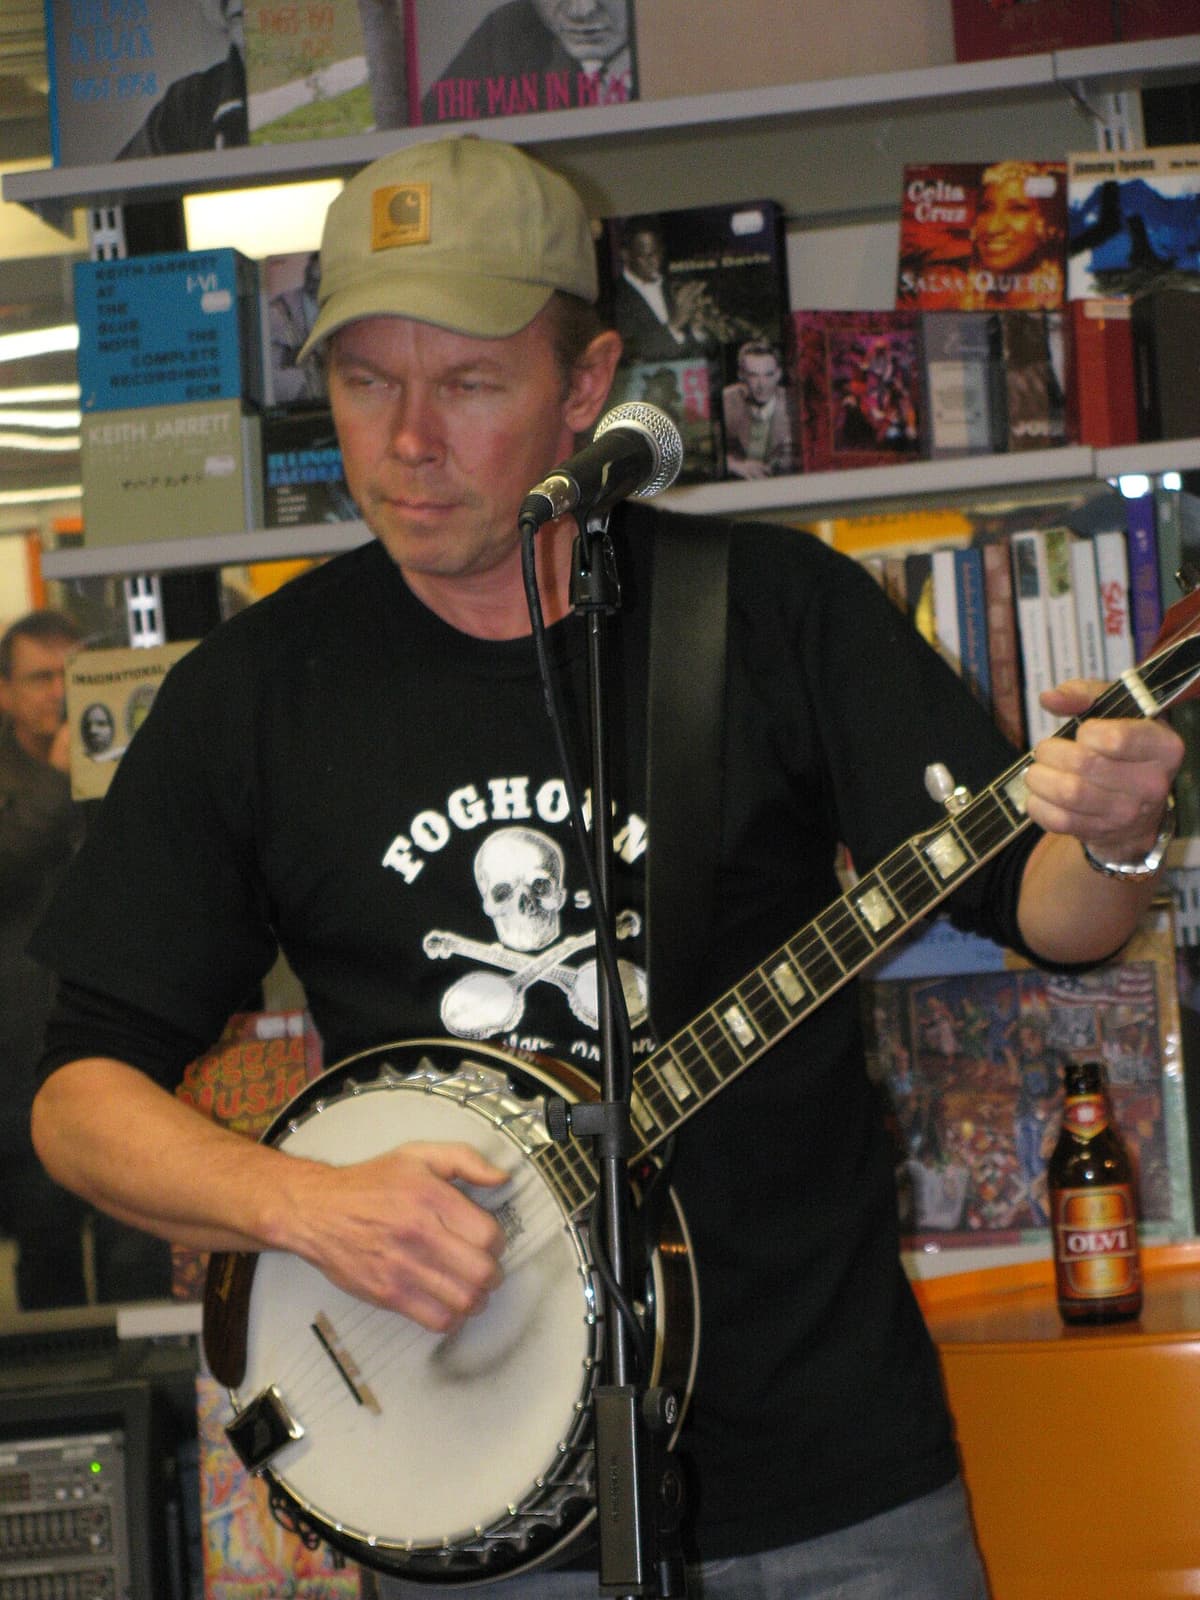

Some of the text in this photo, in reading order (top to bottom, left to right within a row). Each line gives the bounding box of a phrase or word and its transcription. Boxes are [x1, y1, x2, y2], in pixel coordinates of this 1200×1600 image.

[432, 78, 481, 120] THE
[486, 71, 538, 115] MAN
[544, 69, 570, 111] IN
[914, 201, 968, 224] Cruz
[95, 256, 219, 280] KEITH JARRETT
[974, 270, 1058, 294] QUEEN
[88, 413, 230, 446] KEITH JARRETT
[381, 776, 648, 885] FOGHON
[1066, 1230, 1129, 1253] OLVI
